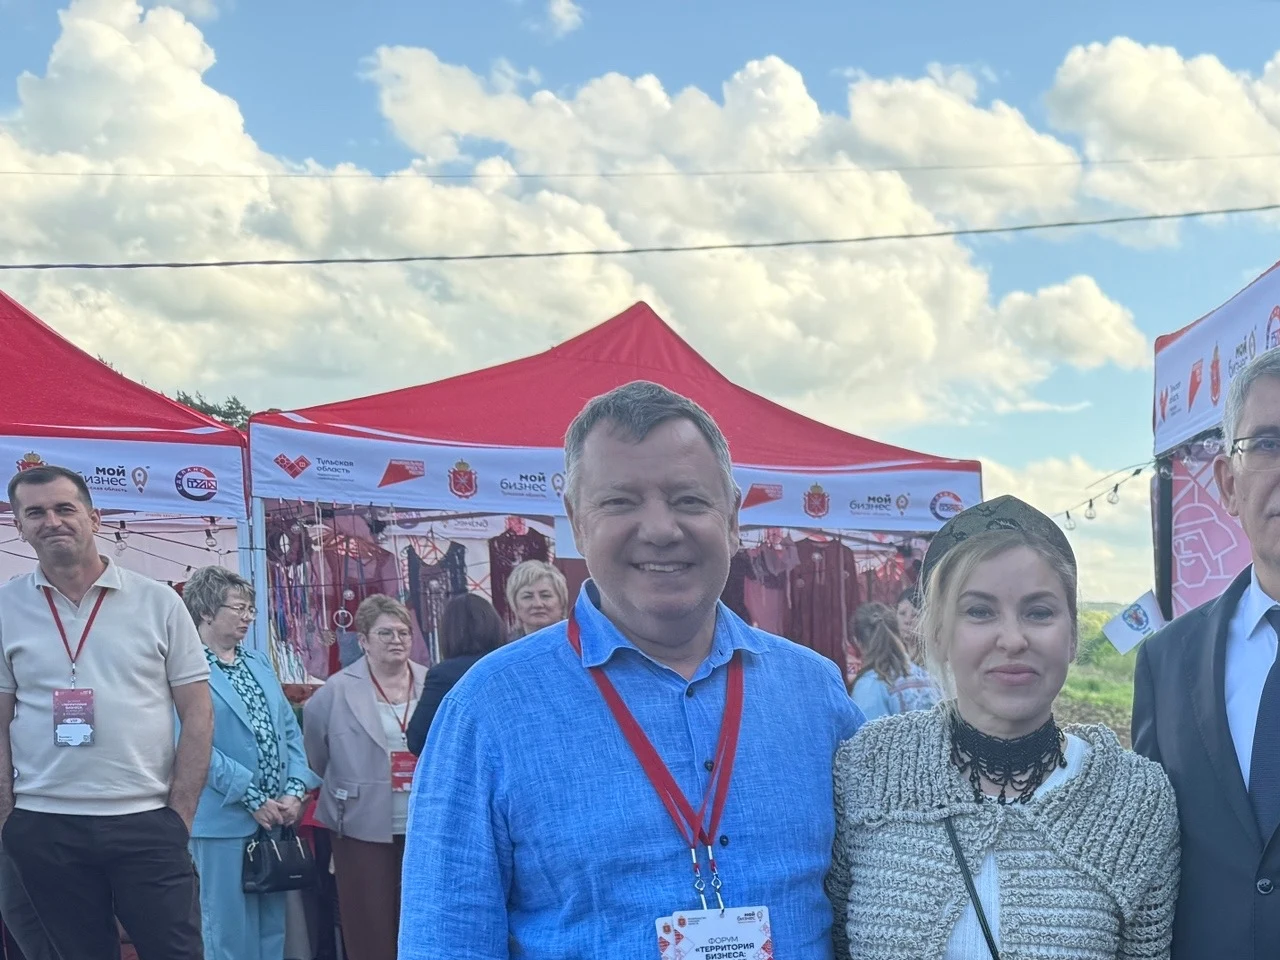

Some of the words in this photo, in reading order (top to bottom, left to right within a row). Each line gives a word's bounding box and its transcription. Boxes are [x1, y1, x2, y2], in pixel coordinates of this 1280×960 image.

[315, 457, 354, 467] Тульская
[95, 465, 126, 477] мой
[316, 466, 351, 474] область
[80, 473, 127, 488] изнес
[519, 472, 546, 483] мой
[500, 478, 547, 492] бизнес
[867, 494, 892, 504] мой
[849, 499, 892, 511] бизнес
[708, 936, 739, 945] ФОРУМ
[695, 942, 755, 953] «ТЕРРИТОРИЯ
[705, 951, 747, 960] БИЗНЕСА:
